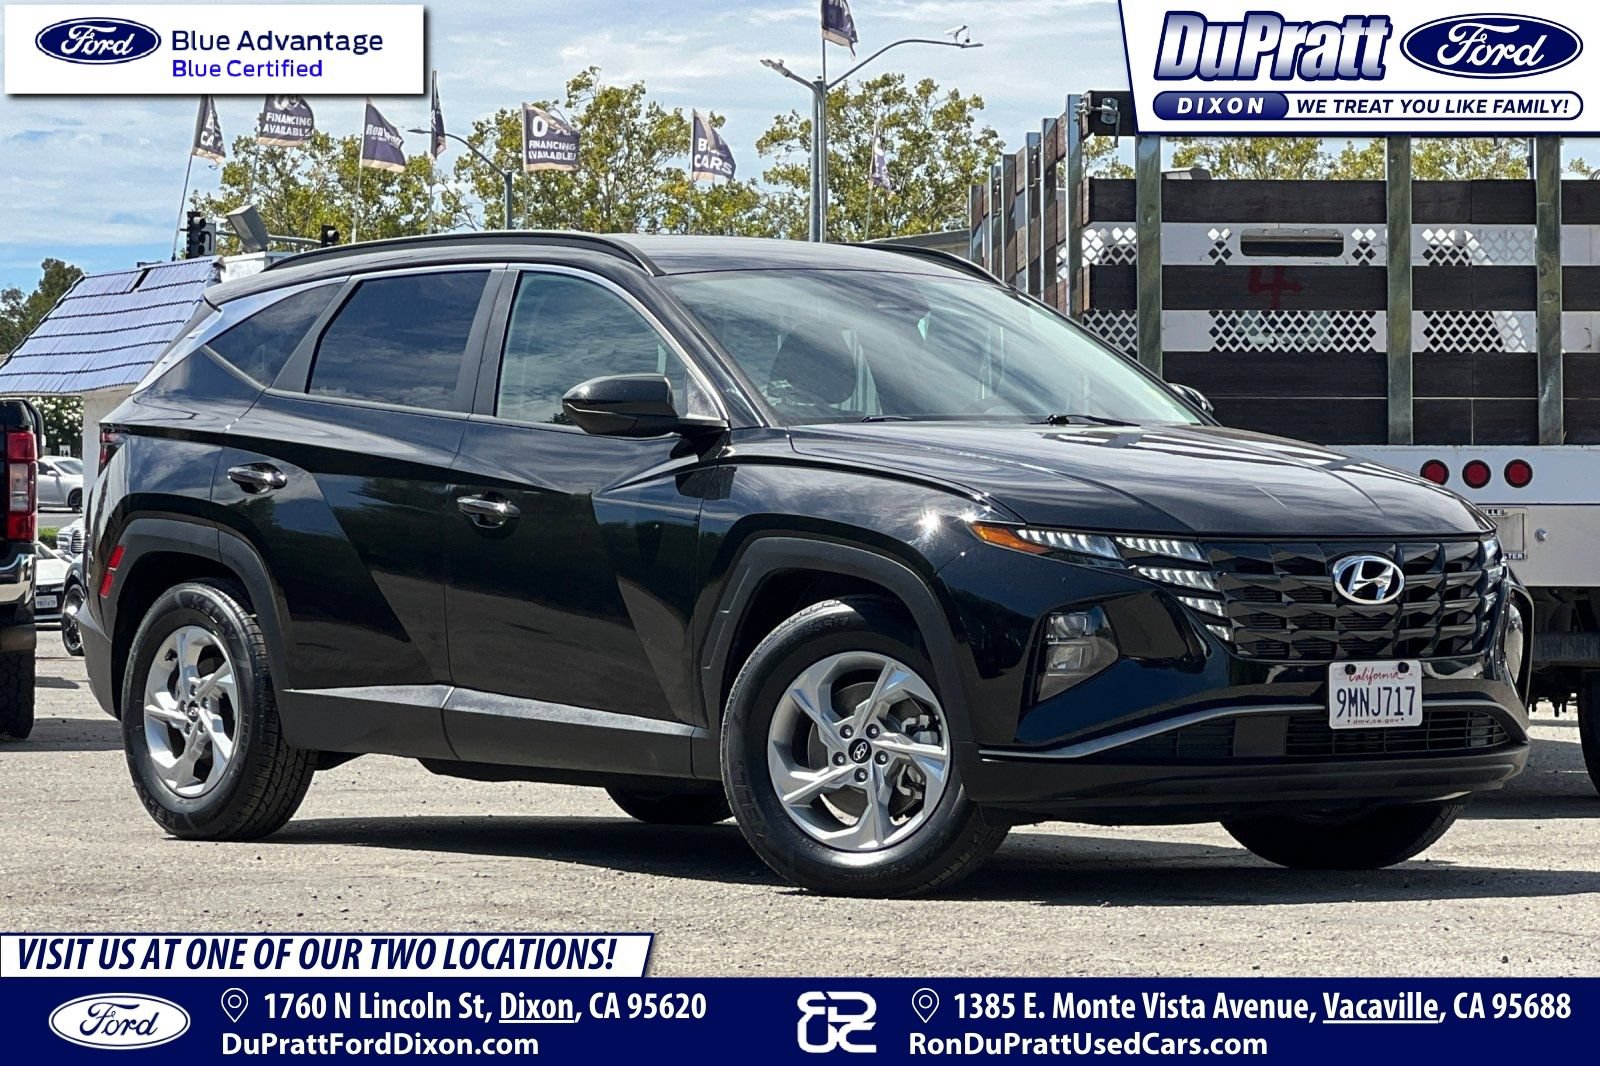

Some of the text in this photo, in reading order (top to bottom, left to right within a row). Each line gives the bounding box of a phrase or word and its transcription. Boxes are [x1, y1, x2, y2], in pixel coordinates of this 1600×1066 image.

[266, 112, 313, 127] FINANCING
[529, 140, 577, 151] FINANCING
[694, 153, 733, 175] CARS
[1348, 667, 1404, 685] California
[1336, 686, 1416, 718] 9MNJ717
